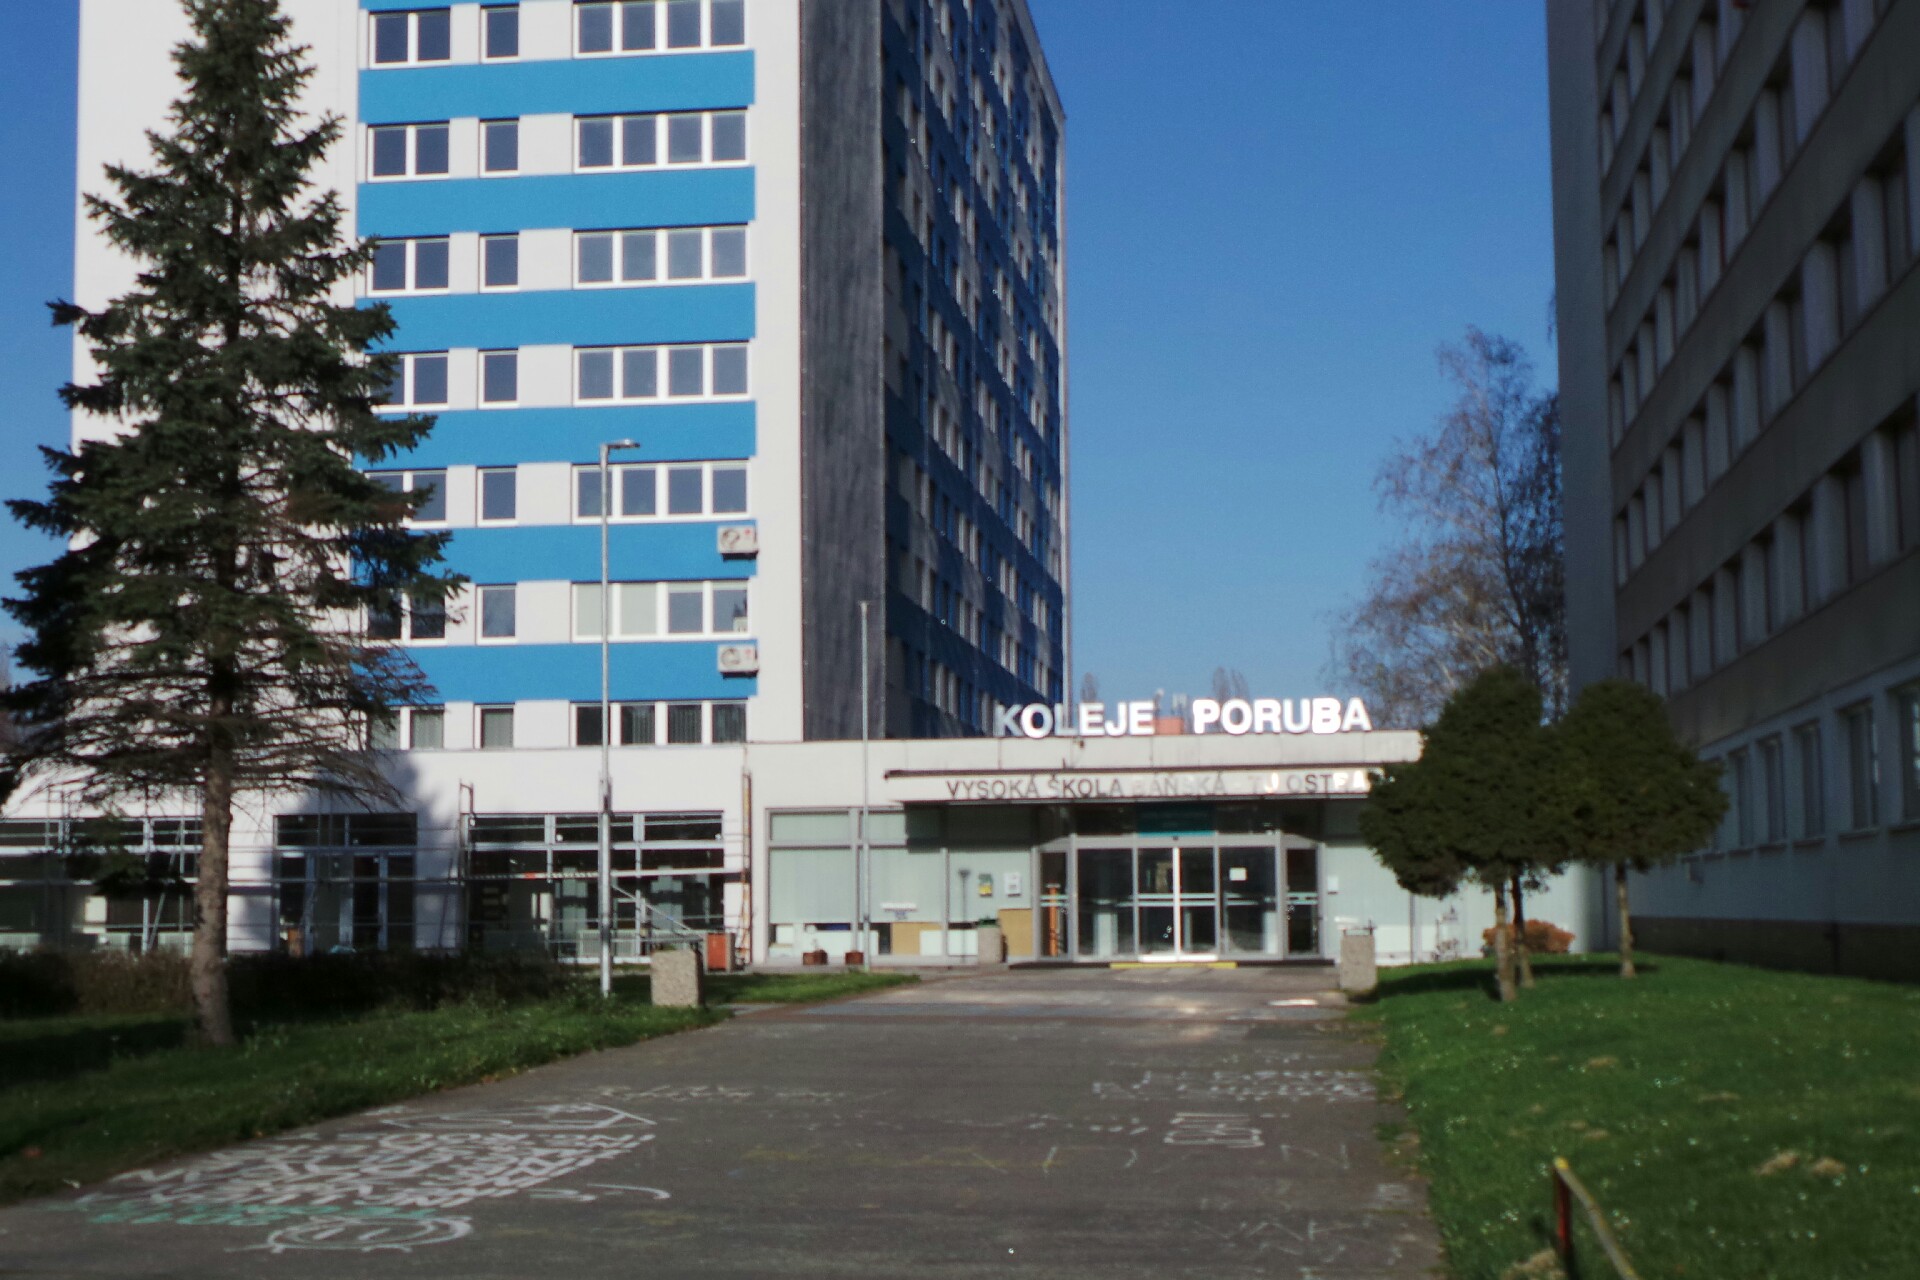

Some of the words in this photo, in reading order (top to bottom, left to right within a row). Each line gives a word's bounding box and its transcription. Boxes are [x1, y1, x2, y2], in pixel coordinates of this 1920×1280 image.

[993, 701, 1155, 738] KOLEJE
[1192, 697, 1372, 735] PORUBA
[946, 773, 1041, 799] VYSOKÁ
[1048, 771, 1123, 798] ŠKOLA
